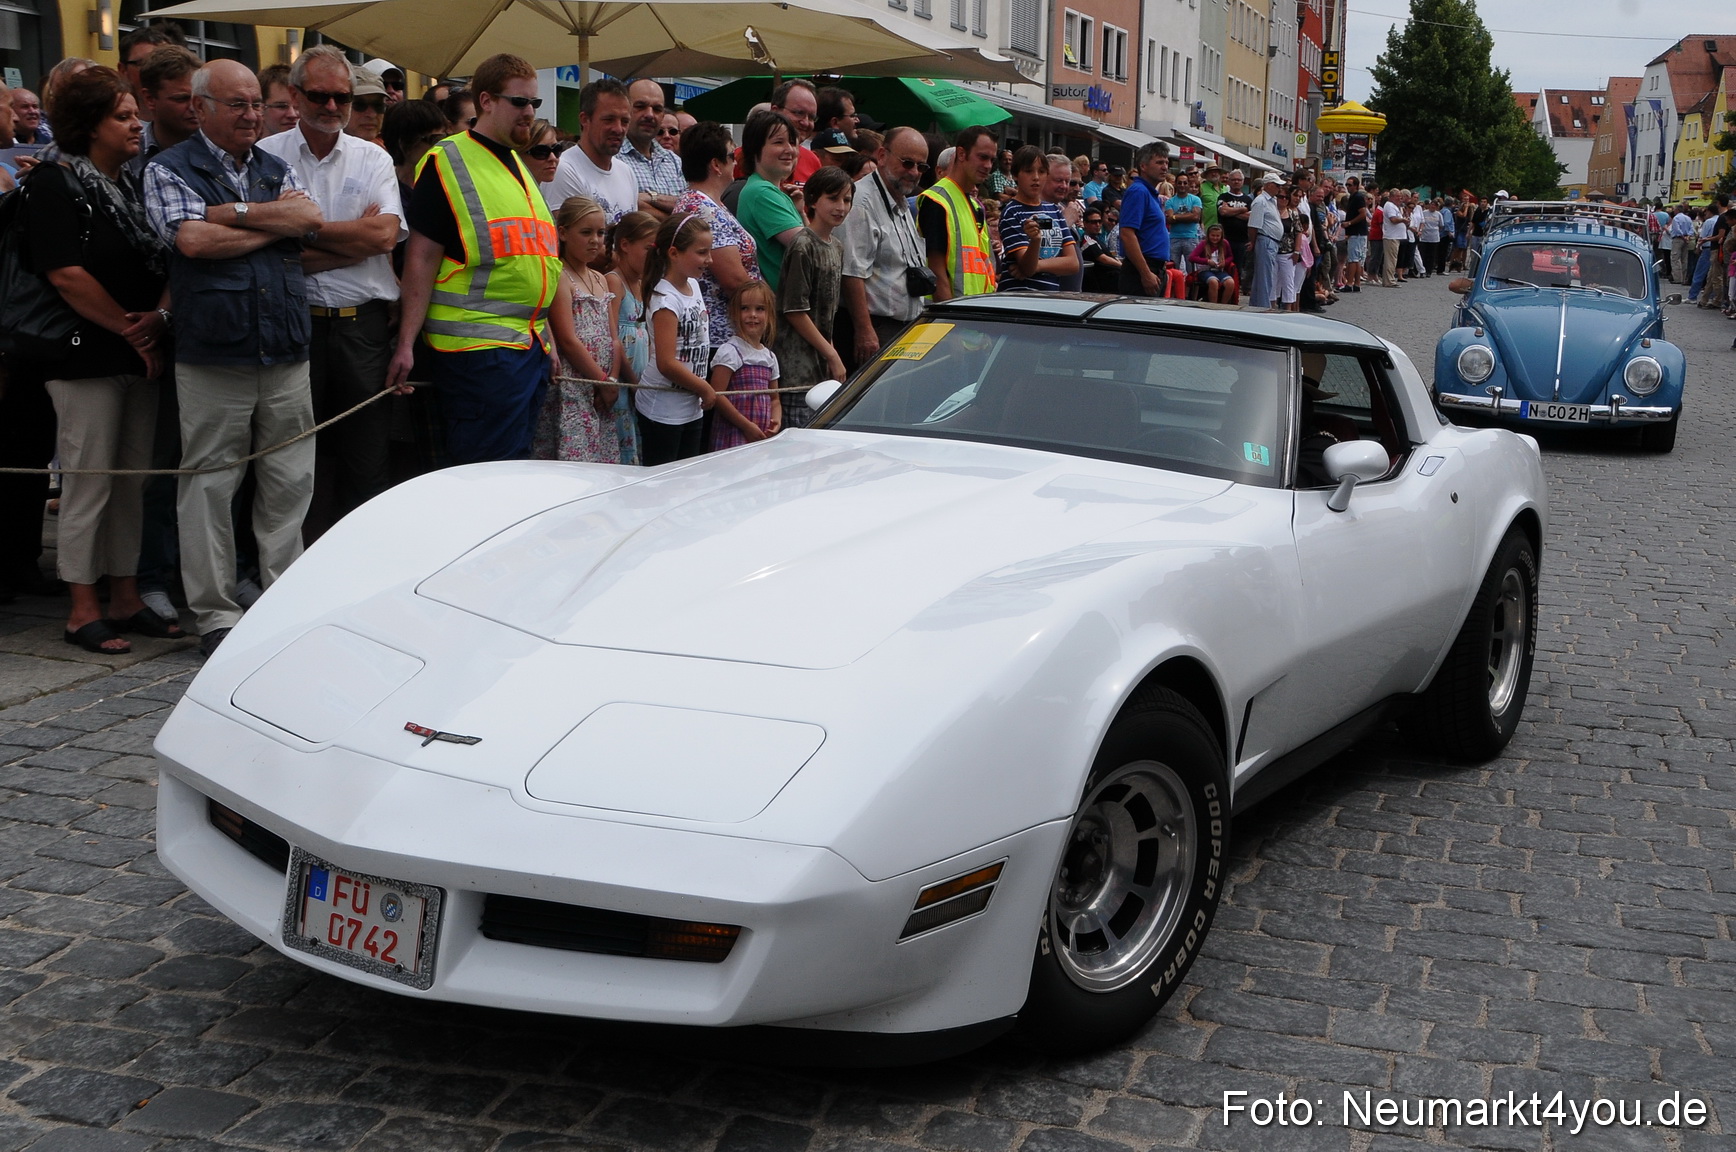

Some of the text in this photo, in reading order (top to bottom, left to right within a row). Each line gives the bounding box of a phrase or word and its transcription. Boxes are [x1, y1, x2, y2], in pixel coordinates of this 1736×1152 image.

[1529, 404, 1539, 417] N
[332, 874, 371, 916] FÜ
[1150, 782, 1222, 998] COOPER COBRA
[327, 912, 399, 964] 0742
